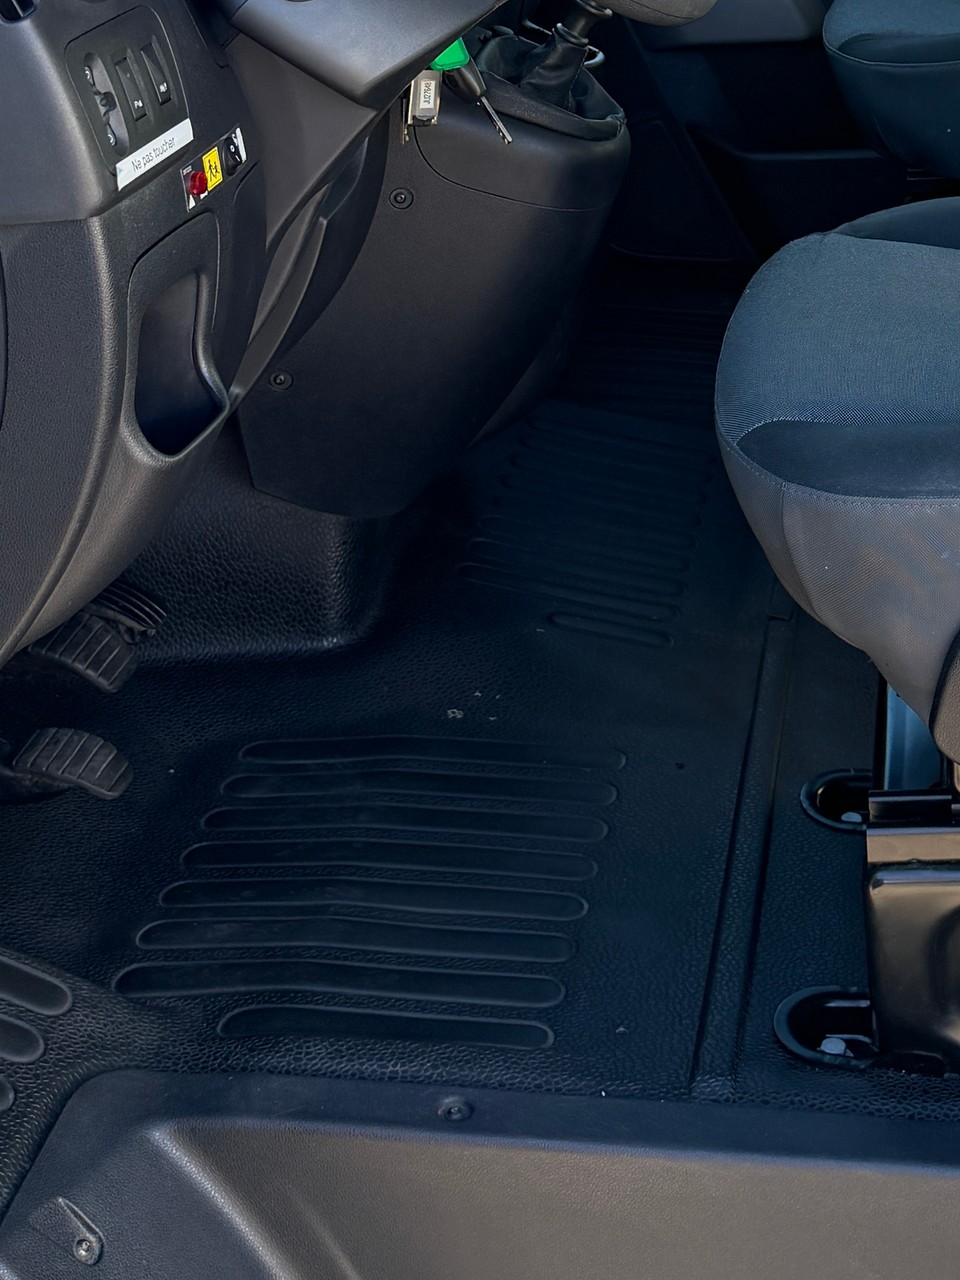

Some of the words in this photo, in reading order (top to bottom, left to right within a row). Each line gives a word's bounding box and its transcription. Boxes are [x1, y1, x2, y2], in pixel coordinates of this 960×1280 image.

[131, 159, 142, 172] Ne
[142, 152, 154, 168] pas
[153, 137, 175, 158] toucher
